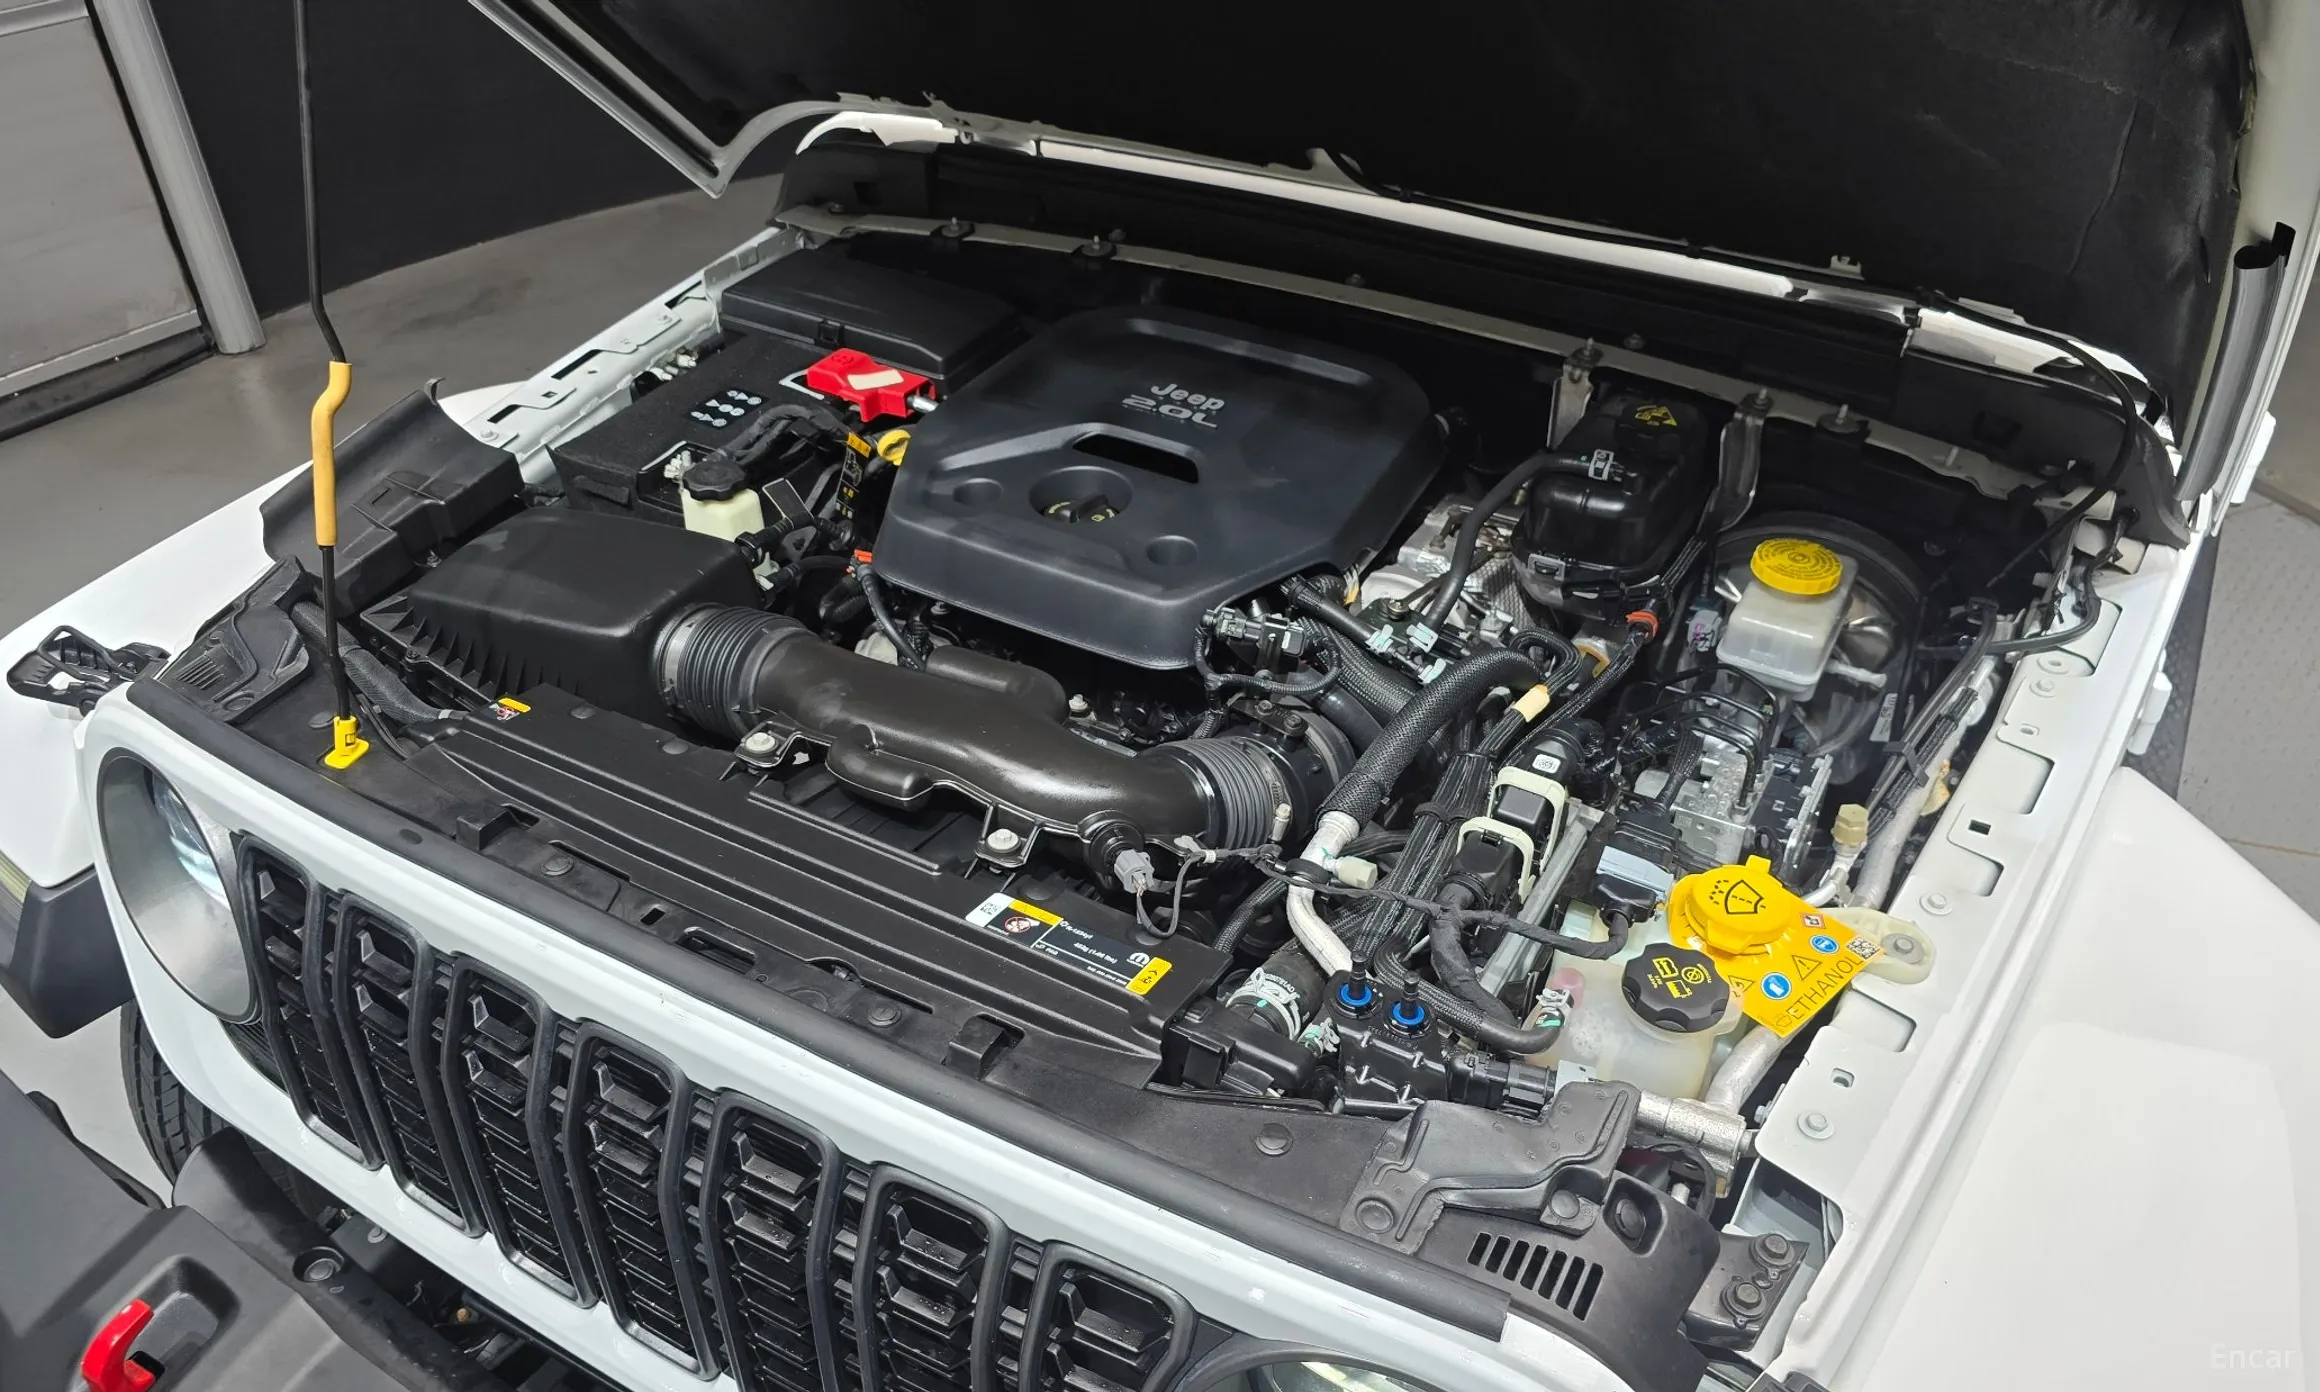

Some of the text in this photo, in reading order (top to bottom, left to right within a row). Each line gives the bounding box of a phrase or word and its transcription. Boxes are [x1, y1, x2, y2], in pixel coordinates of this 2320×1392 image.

[1122, 394, 1218, 428] 2.0L
[1150, 383, 1225, 410] Jeep
[1786, 955, 1864, 1020] ETHANOL
